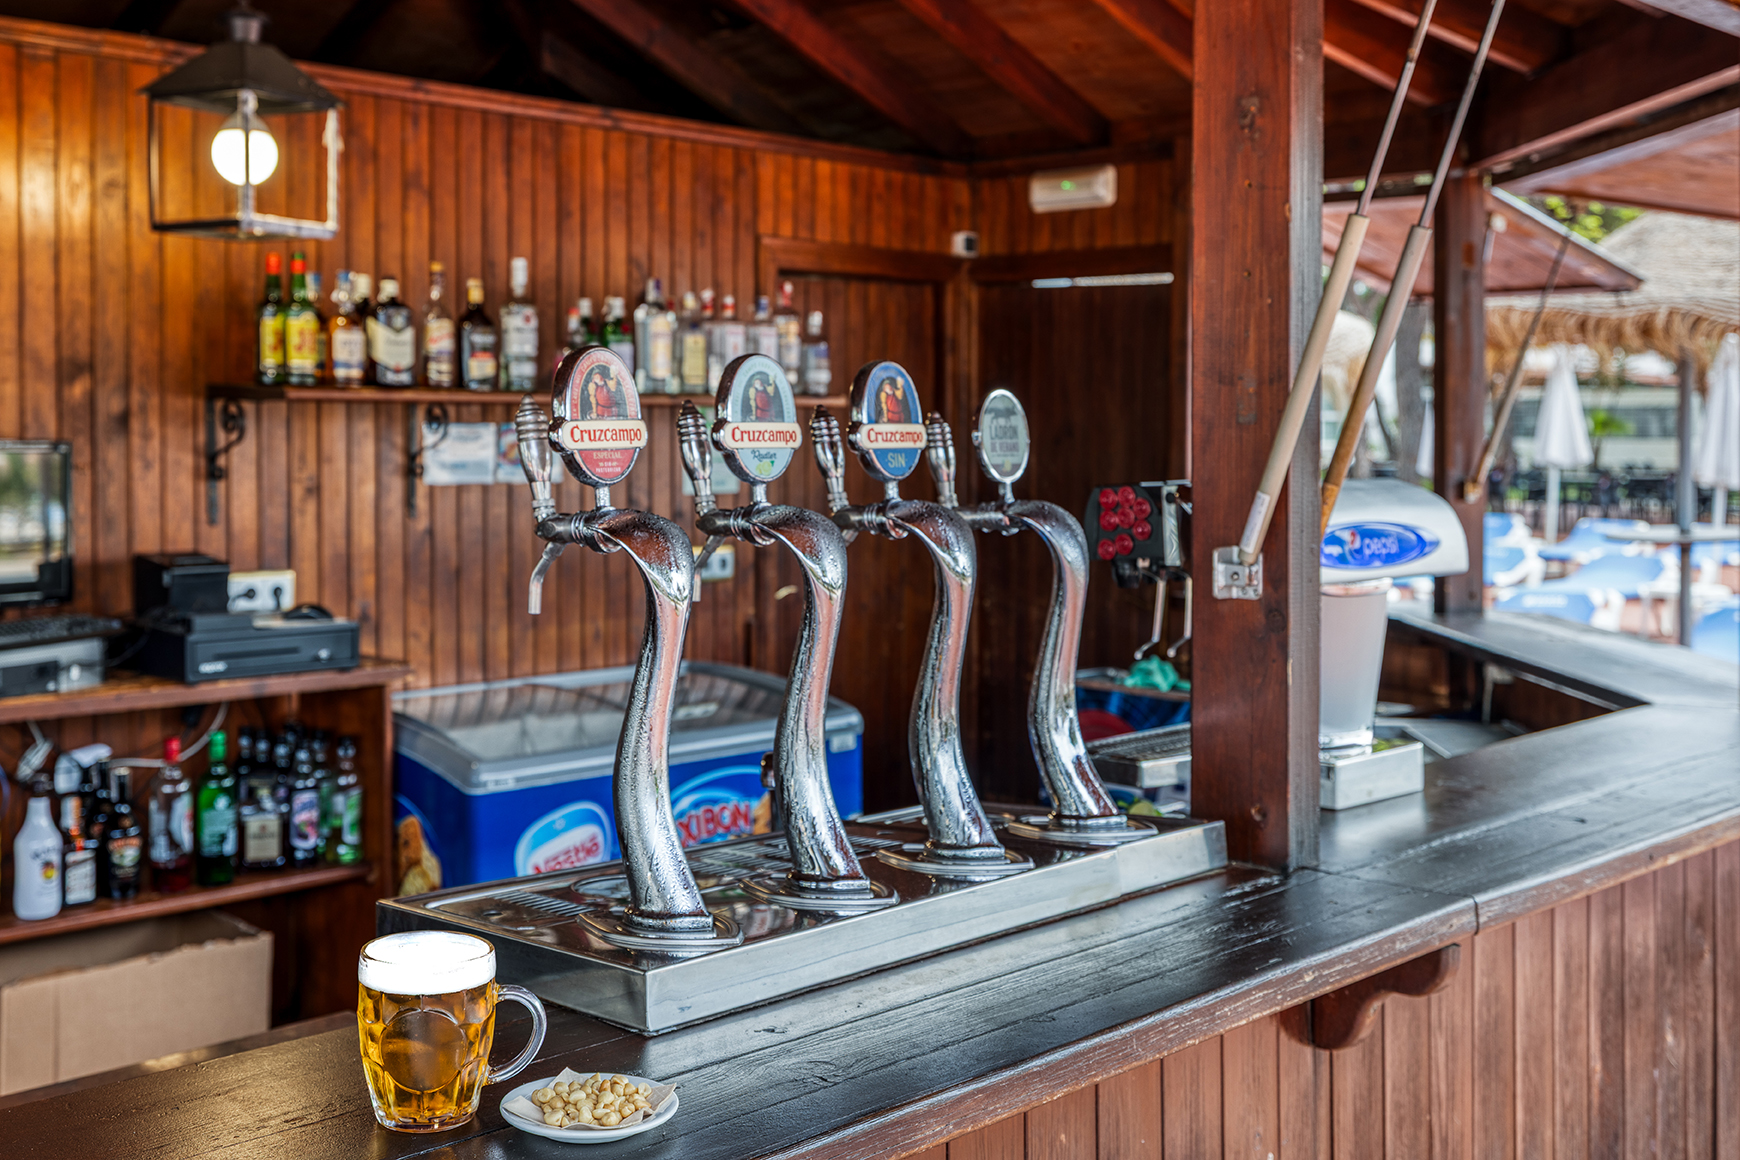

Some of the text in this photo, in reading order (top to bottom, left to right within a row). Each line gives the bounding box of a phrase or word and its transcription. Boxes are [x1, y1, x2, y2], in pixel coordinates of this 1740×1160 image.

[570, 424, 642, 445] Cruzcampo
[731, 426, 797, 445] Cruzcampo
[867, 427, 924, 445] Cruzcampo
[593, 451, 622, 460] ESPECIAL
[751, 449, 777, 462] Radler
[887, 452, 906, 468] SIN
[1363, 532, 1398, 560] pepsi
